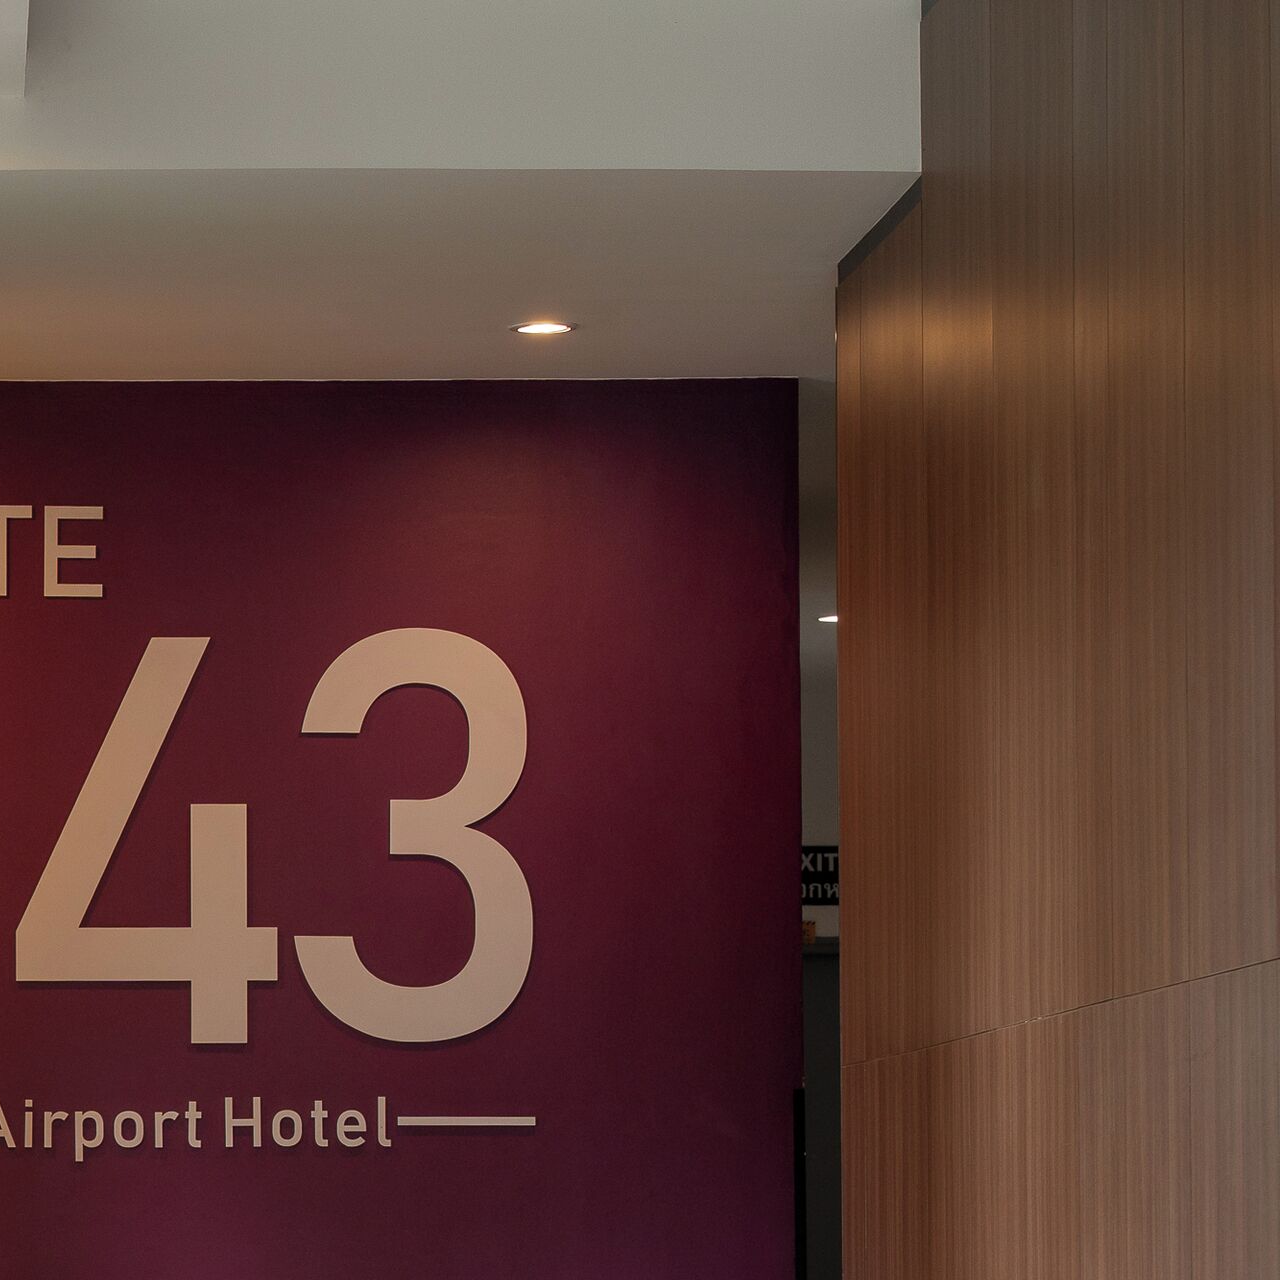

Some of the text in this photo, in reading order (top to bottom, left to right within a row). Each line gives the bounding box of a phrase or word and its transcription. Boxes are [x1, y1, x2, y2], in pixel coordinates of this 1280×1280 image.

[14, 626, 535, 1045] 43
[801, 852, 839, 872] XIT
[224, 1095, 393, 1149] Hotel
